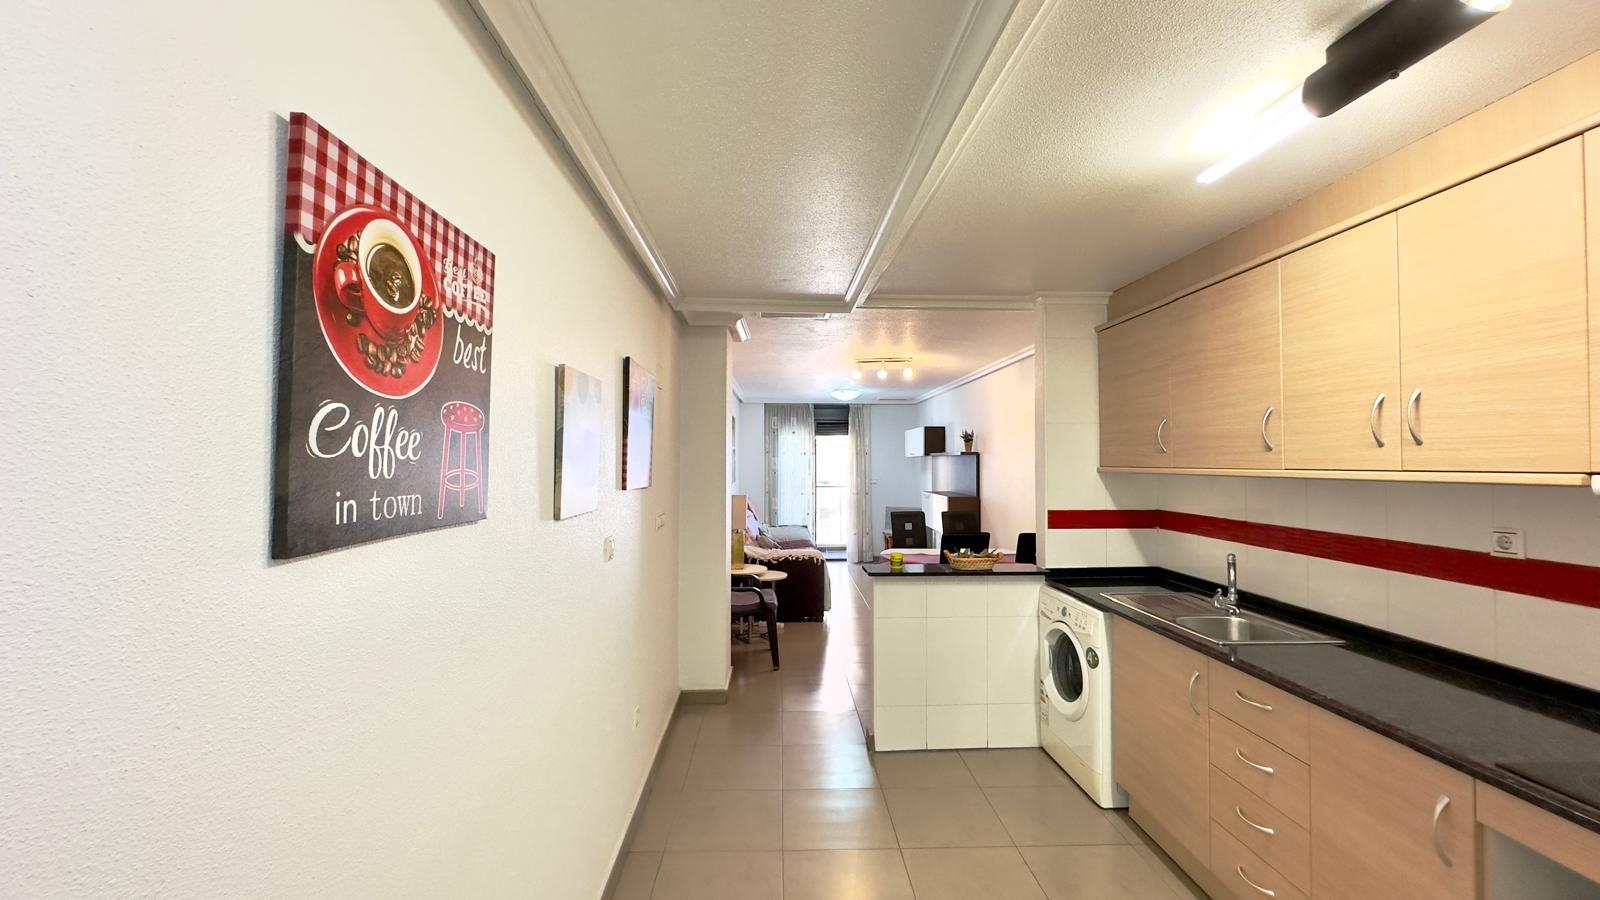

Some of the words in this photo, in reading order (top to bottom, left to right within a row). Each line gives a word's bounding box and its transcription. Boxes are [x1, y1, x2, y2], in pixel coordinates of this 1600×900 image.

[453, 324, 487, 374] best
[307, 402, 422, 480] Coffee
[335, 491, 357, 525] in
[369, 490, 423, 521] town
